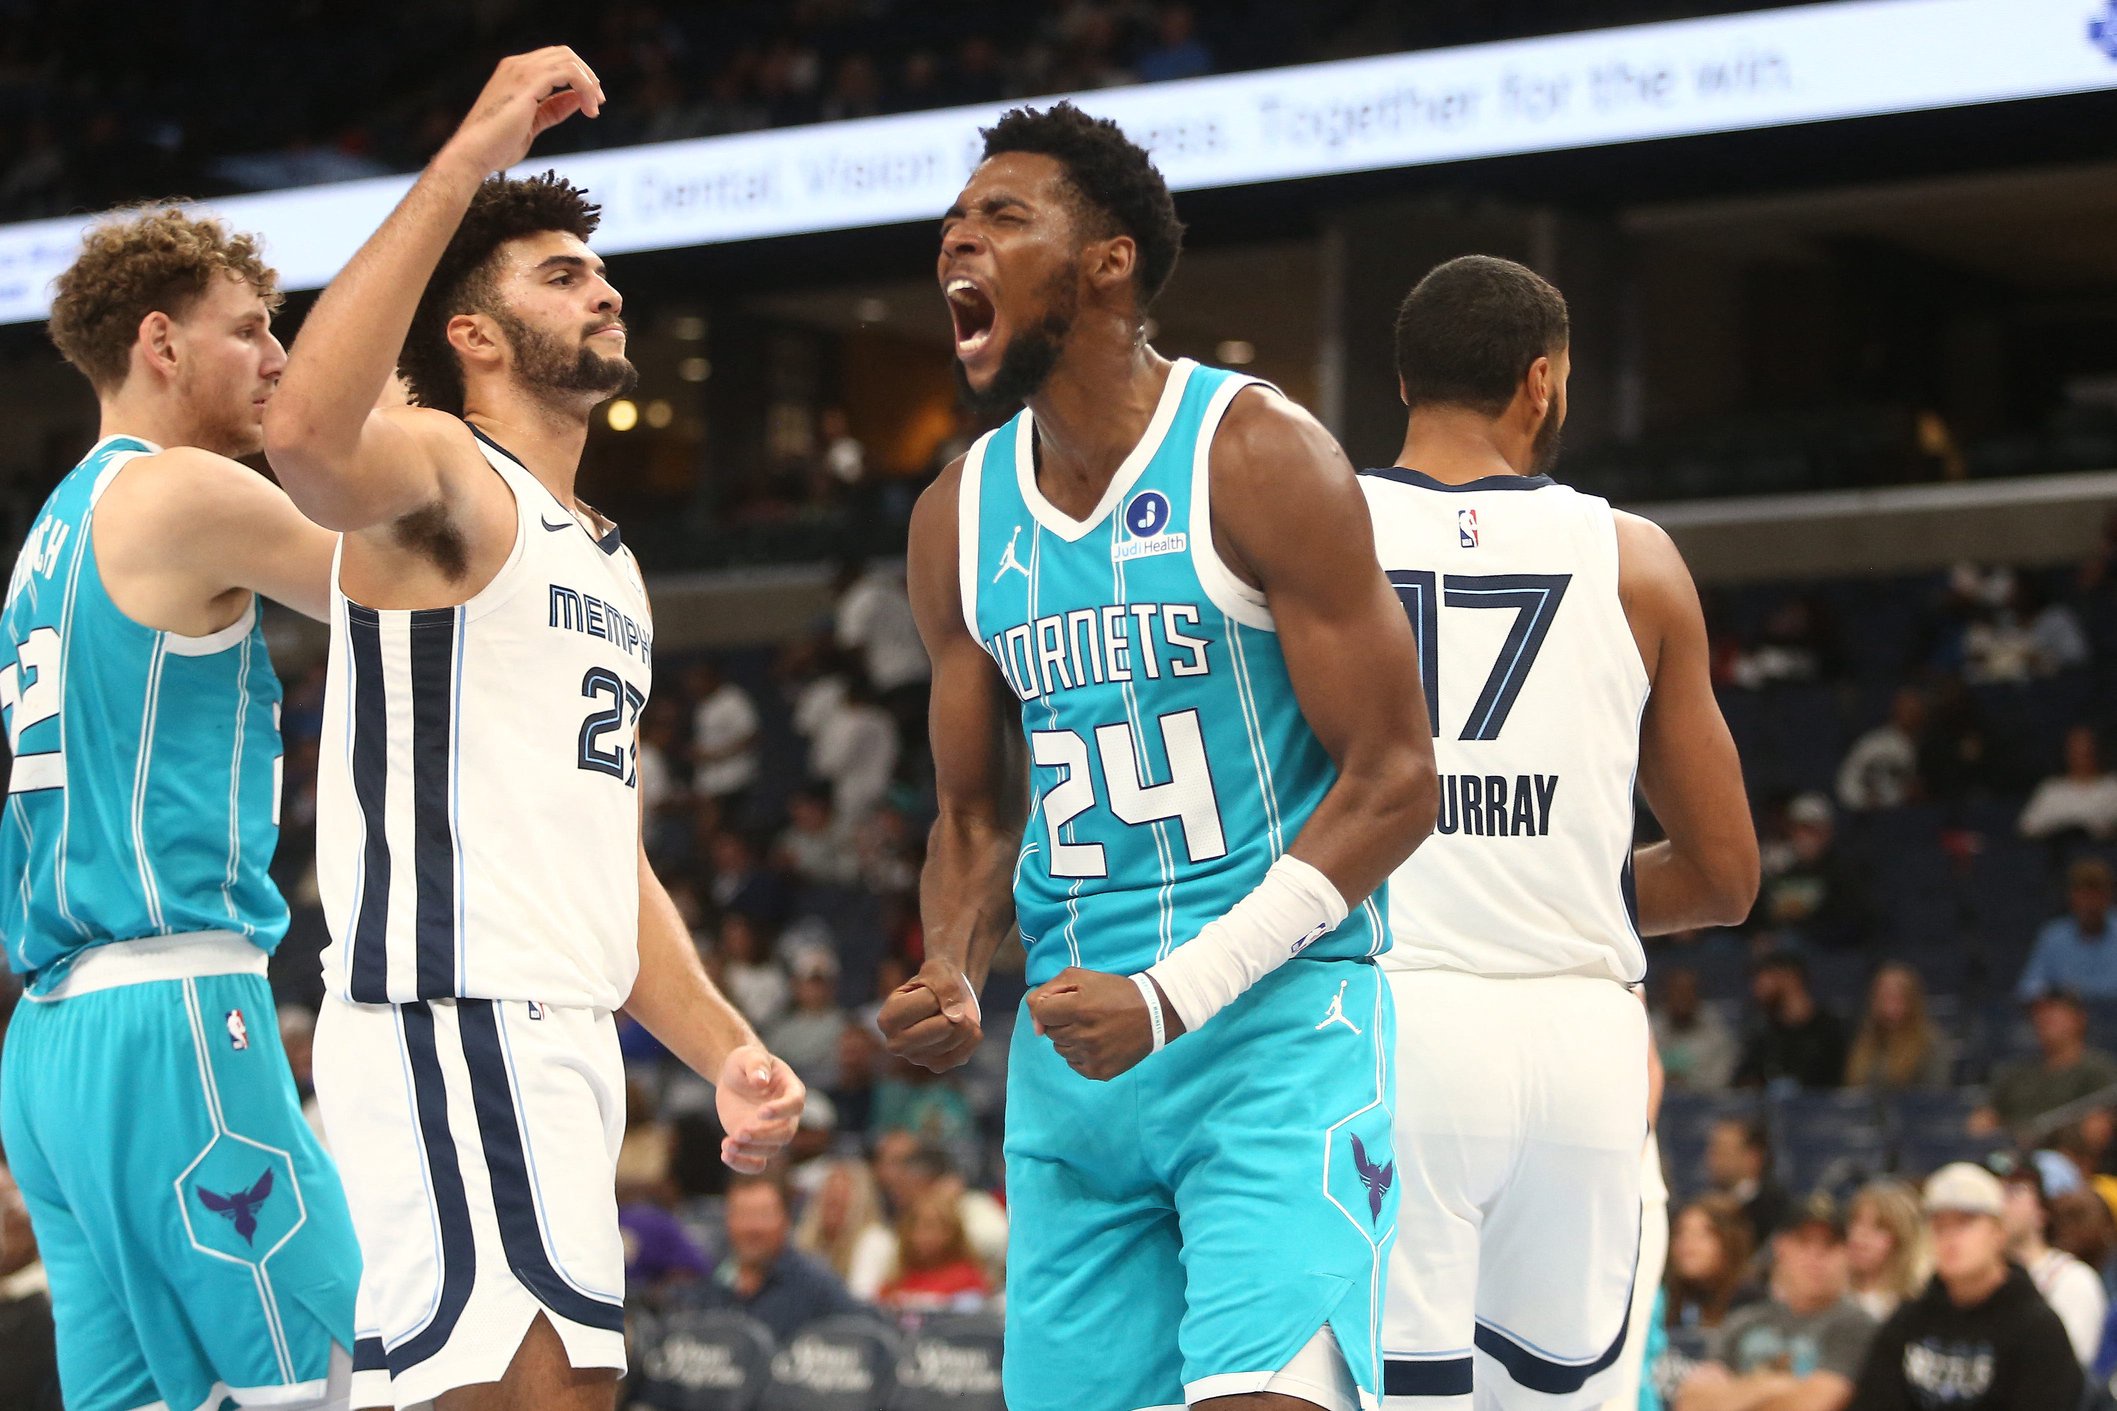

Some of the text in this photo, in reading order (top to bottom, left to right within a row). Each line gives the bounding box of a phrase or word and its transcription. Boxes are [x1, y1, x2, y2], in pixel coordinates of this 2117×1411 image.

[1500, 64, 1572, 120] for
[1590, 56, 1676, 110] the
[1114, 536, 1184, 559] Judi Health
[1031, 706, 1228, 880] 24
[1432, 773, 1559, 837] URRAY
